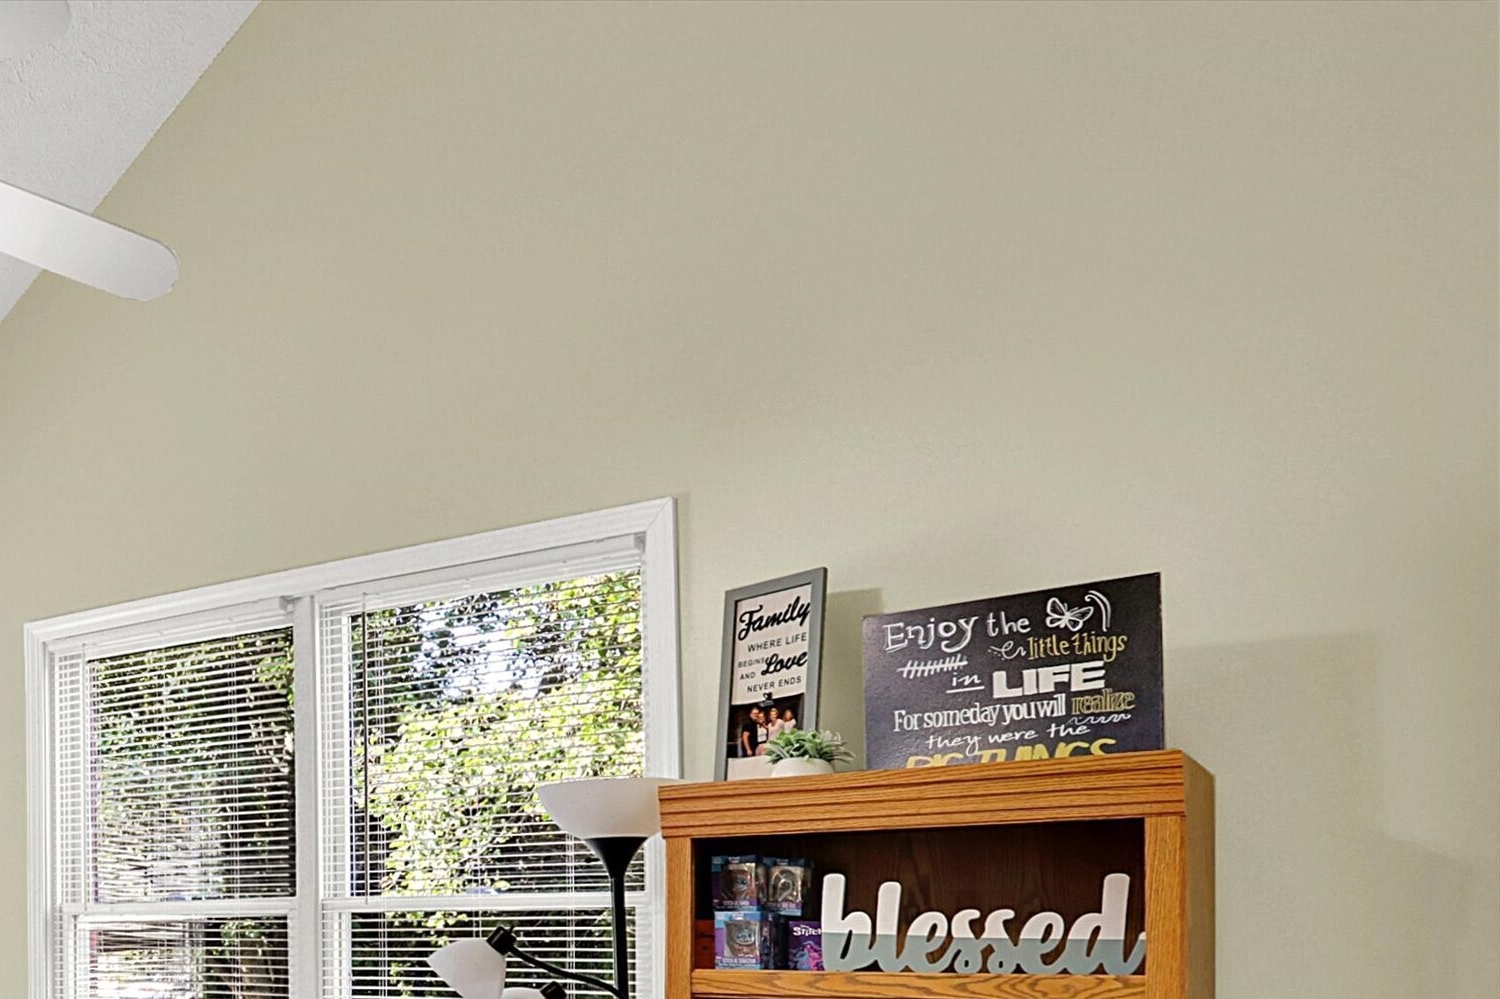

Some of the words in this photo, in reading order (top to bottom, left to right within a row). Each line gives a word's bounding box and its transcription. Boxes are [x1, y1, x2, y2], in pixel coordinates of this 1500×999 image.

[738, 596, 810, 641] Family
[883, 617, 979, 653] Enjoy
[987, 611, 1031, 637] the
[748, 638, 782, 652] WHERE
[785, 632, 807, 645] LIFE
[1026, 635, 1070, 660] little
[1071, 631, 1128, 662] things
[740, 672, 756, 680] AND
[761, 652, 808, 676] Love
[951, 672, 982, 687] in
[992, 660, 1106, 698] LIFE
[747, 681, 775, 692] NEVER
[778, 676, 802, 687] ENDS
[893, 710, 922, 732] For
[923, 702, 1001, 728] someday
[1002, 702, 1036, 726] you
[1036, 693, 1066, 718] will
[1071, 688, 1136, 715] realize
[925, 735, 982, 757] they
[988, 730, 1039, 744] were
[1046, 723, 1091, 738] the
[821, 873, 1146, 974] blessed
